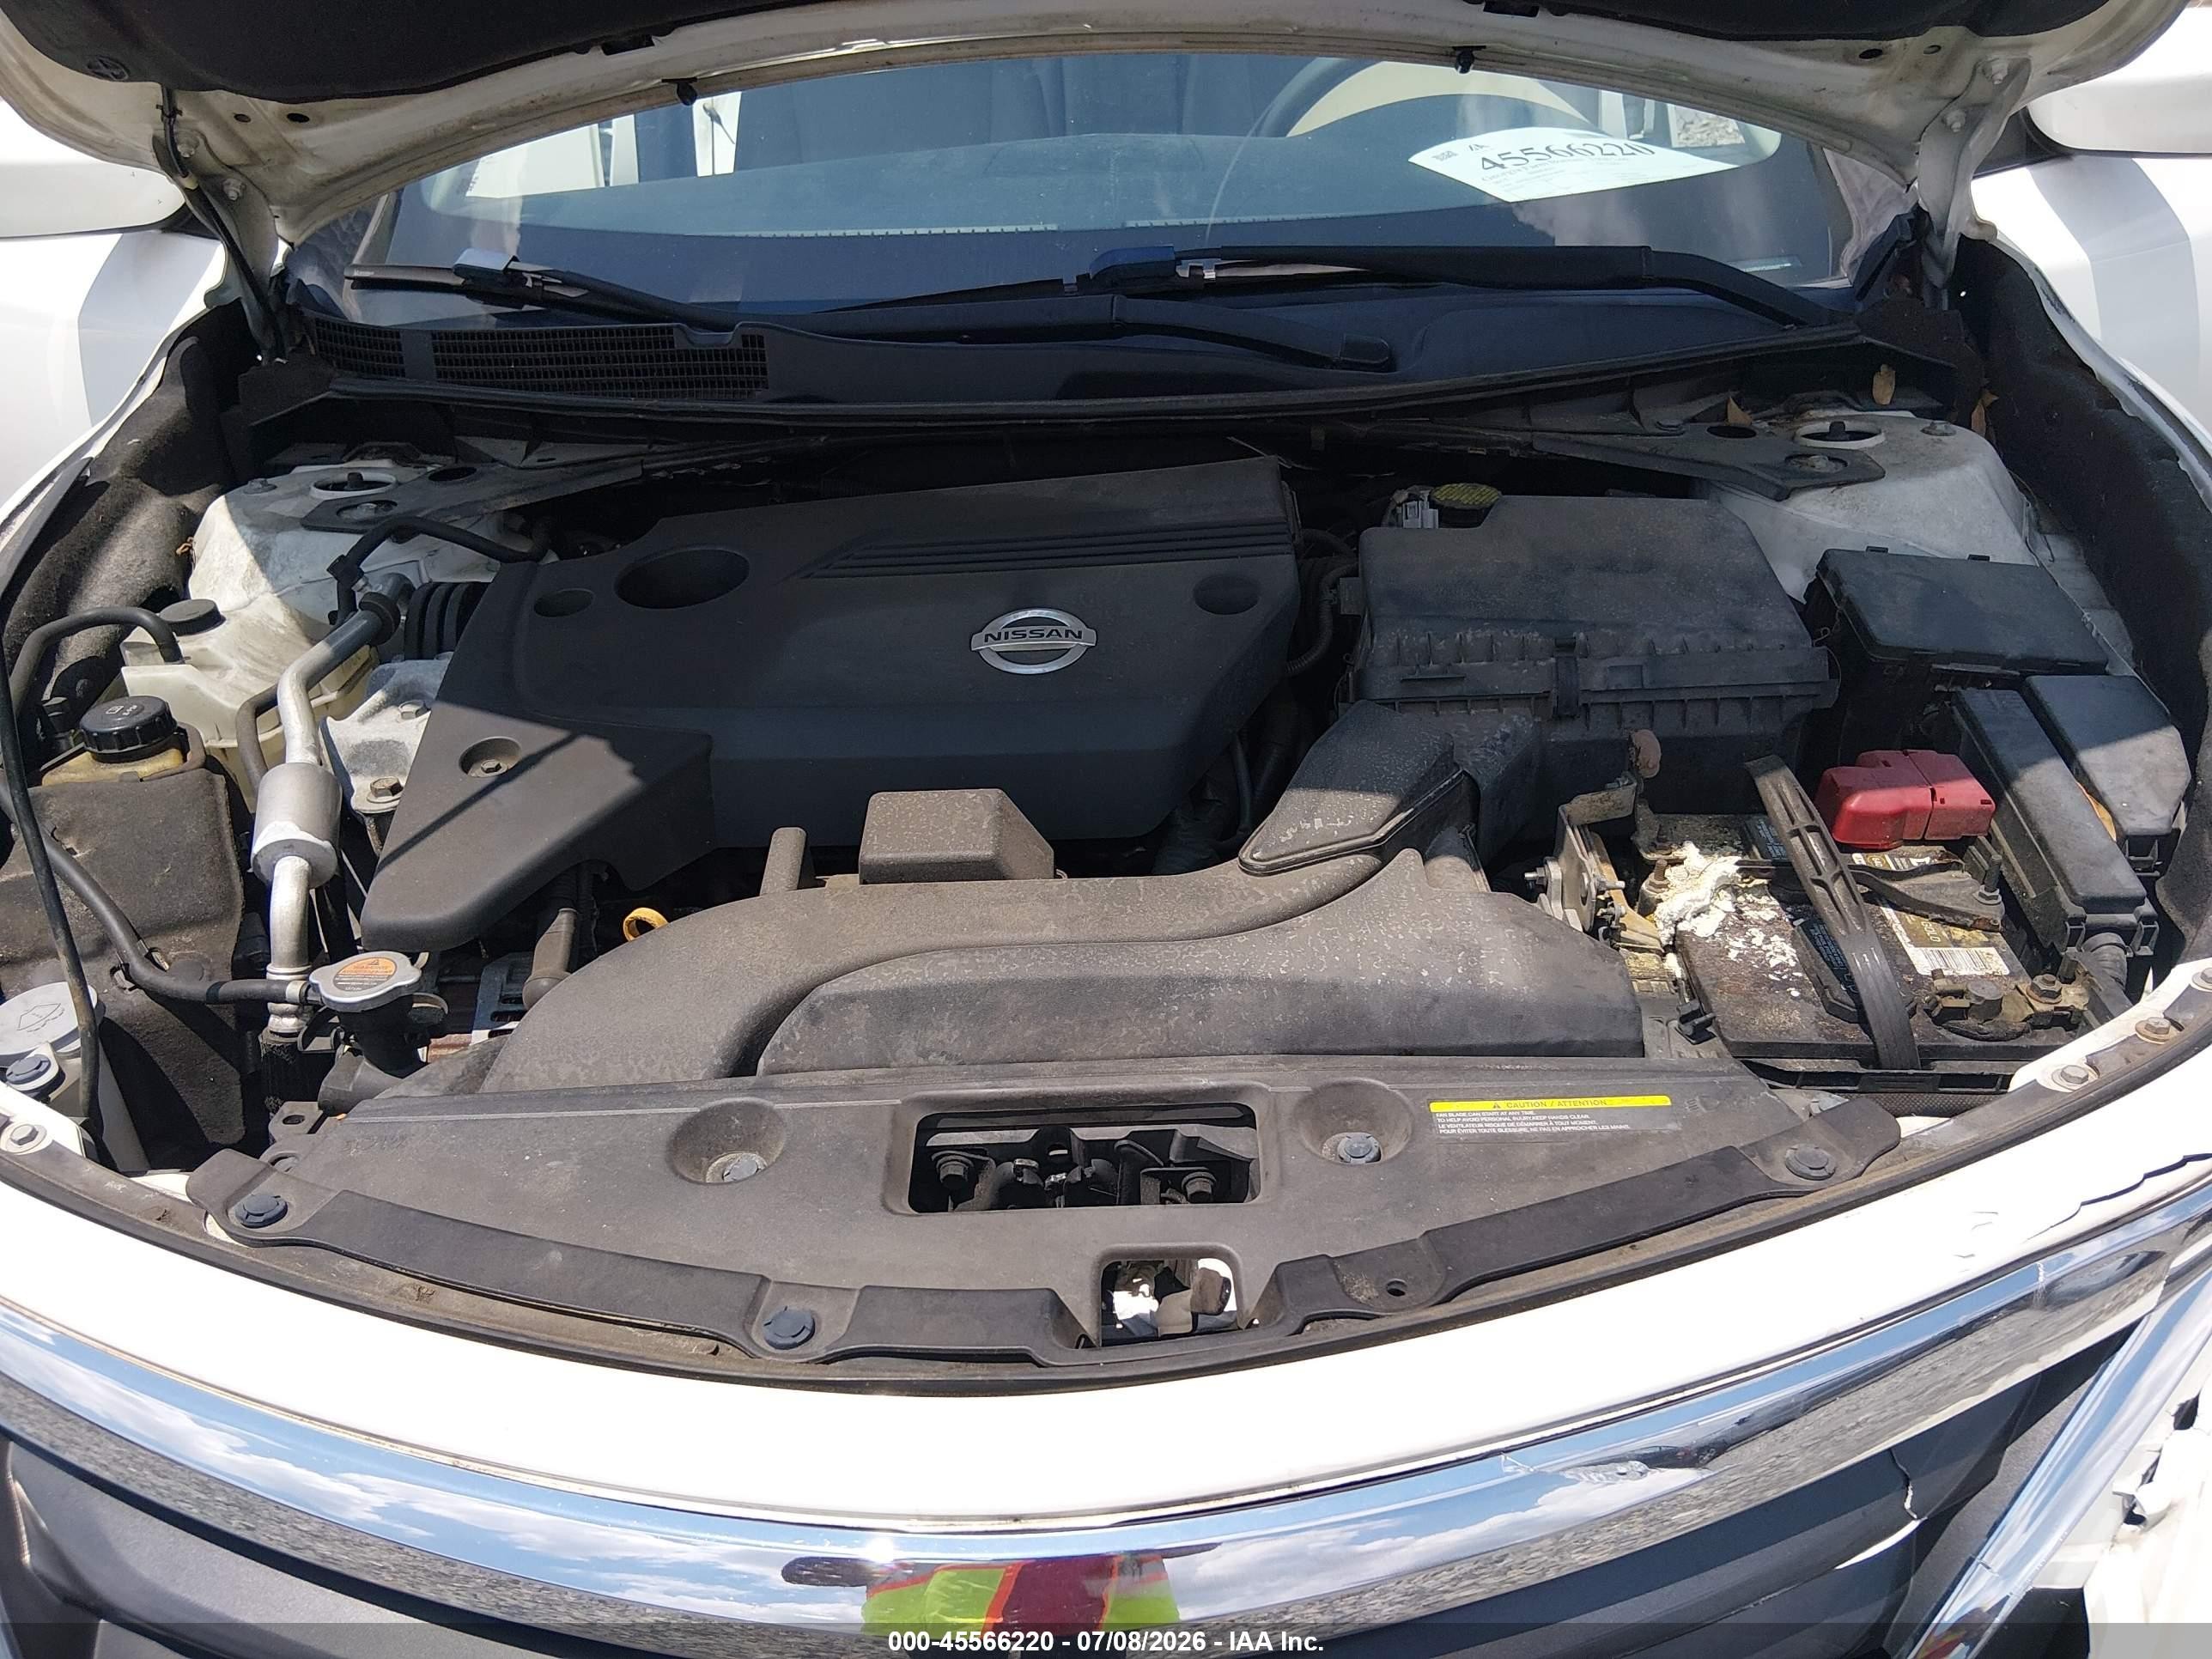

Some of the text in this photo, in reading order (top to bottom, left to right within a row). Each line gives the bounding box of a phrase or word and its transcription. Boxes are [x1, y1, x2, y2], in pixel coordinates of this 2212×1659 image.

[1481, 143, 1655, 169] 45566220
[984, 629, 1083, 643] NISSAN
[1921, 920, 1942, 943] GOLD
